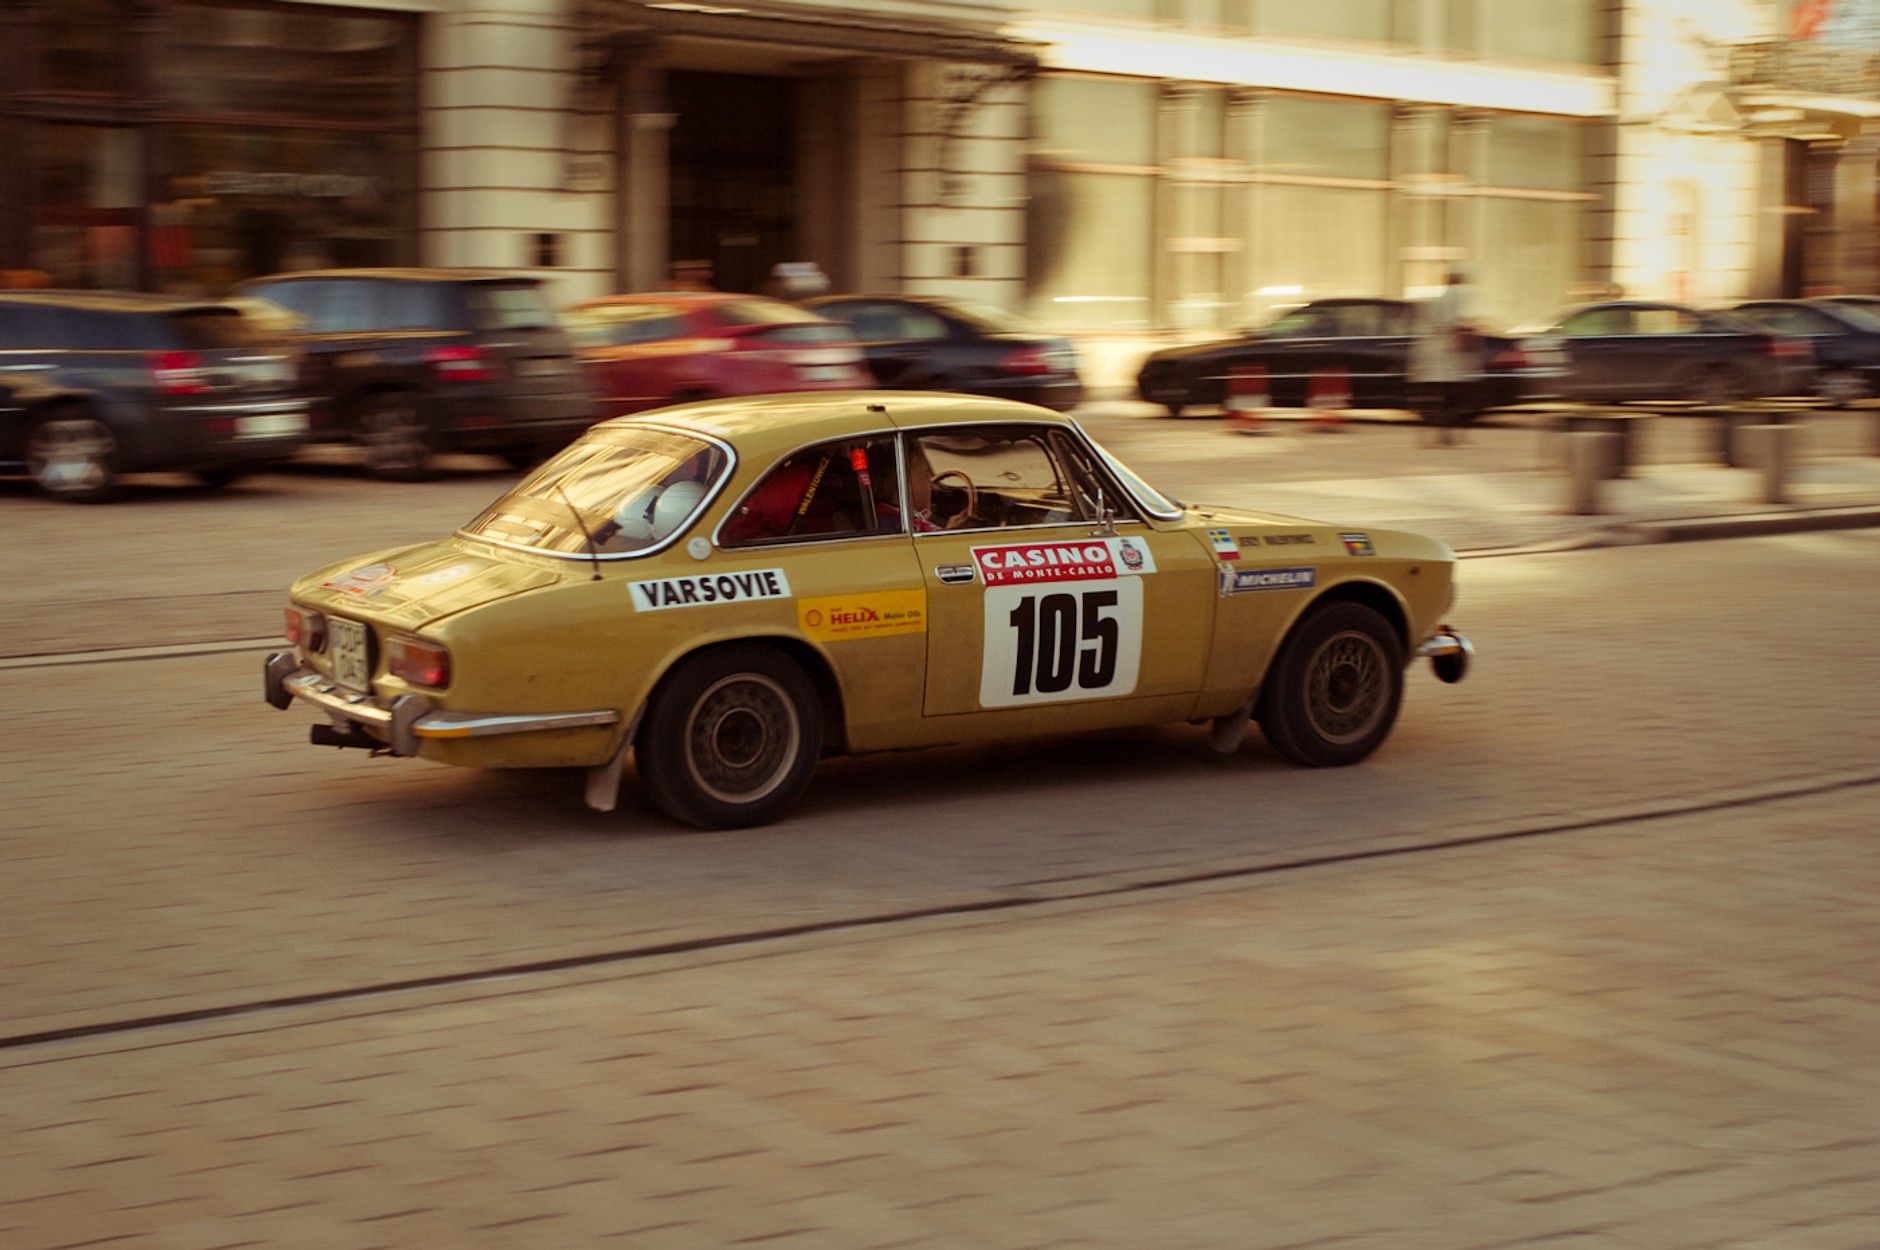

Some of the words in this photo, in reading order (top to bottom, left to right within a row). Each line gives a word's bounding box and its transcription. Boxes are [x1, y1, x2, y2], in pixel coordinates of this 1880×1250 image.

[798, 457, 830, 515] WALENTOWICZ
[981, 546, 1108, 568] CASINO
[987, 572, 1004, 581] DE
[1013, 565, 1113, 579] MONTE-CARLO
[1238, 571, 1315, 587] MICHELIN
[640, 572, 781, 607] VARSOVIE
[830, 610, 880, 625] HELIX
[884, 612, 905, 620] Motor
[907, 609, 921, 618] Oils
[1010, 590, 1118, 695] 105
